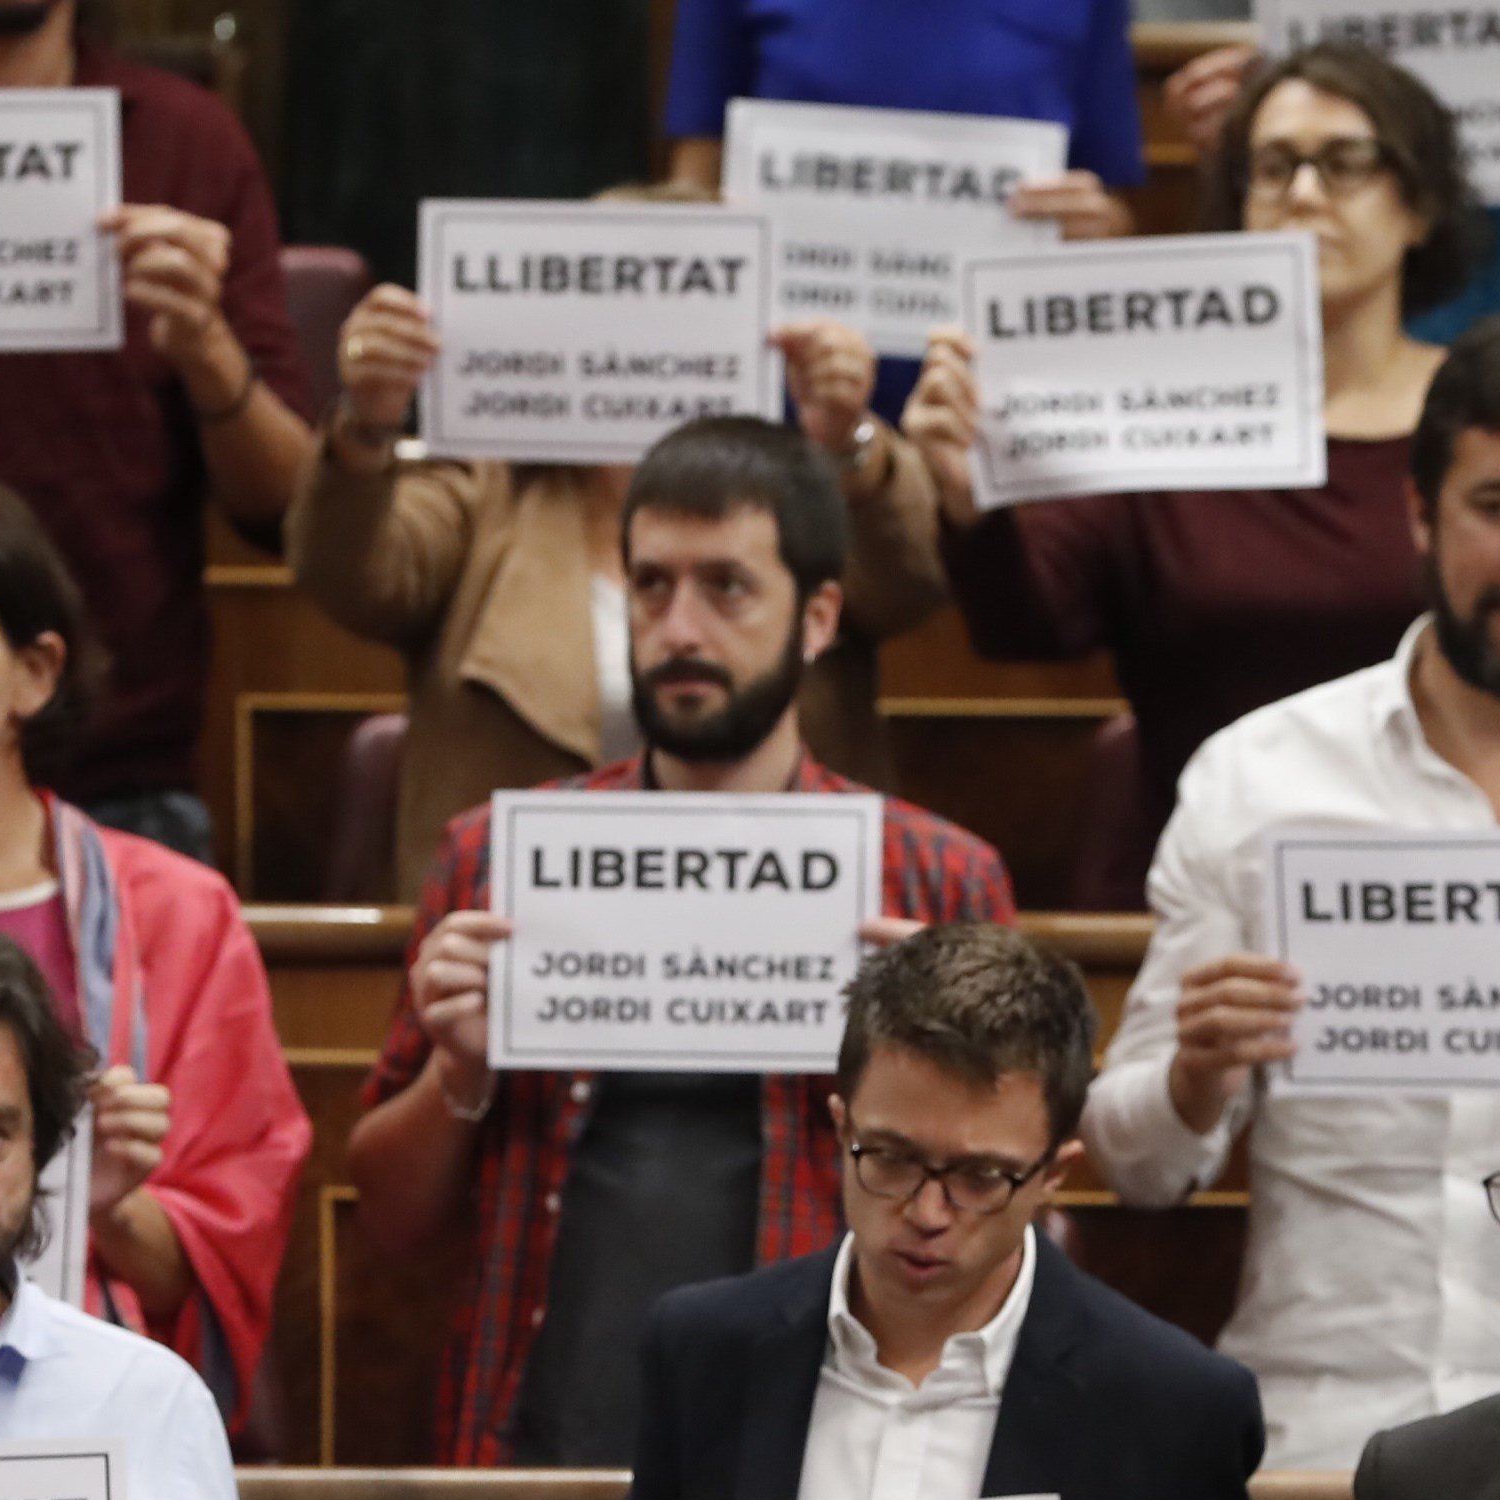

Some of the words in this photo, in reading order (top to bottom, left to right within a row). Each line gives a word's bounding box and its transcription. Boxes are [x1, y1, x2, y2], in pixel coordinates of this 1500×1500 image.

[454, 255, 744, 293] LLIBERTAT
[988, 286, 1279, 338] LIBERTAD
[997, 394, 1100, 419] JORDI
[1008, 431, 1108, 458] JORDI
[532, 847, 839, 892] LIBERTAD
[532, 951, 646, 980] JORDI
[662, 946, 834, 982] SÀNCHEZ
[536, 997, 651, 1024] JORDI
[666, 998, 828, 1025] CUIXART
[1310, 984, 1421, 1010] JORDI
[1315, 1027, 1429, 1054] JORDI
